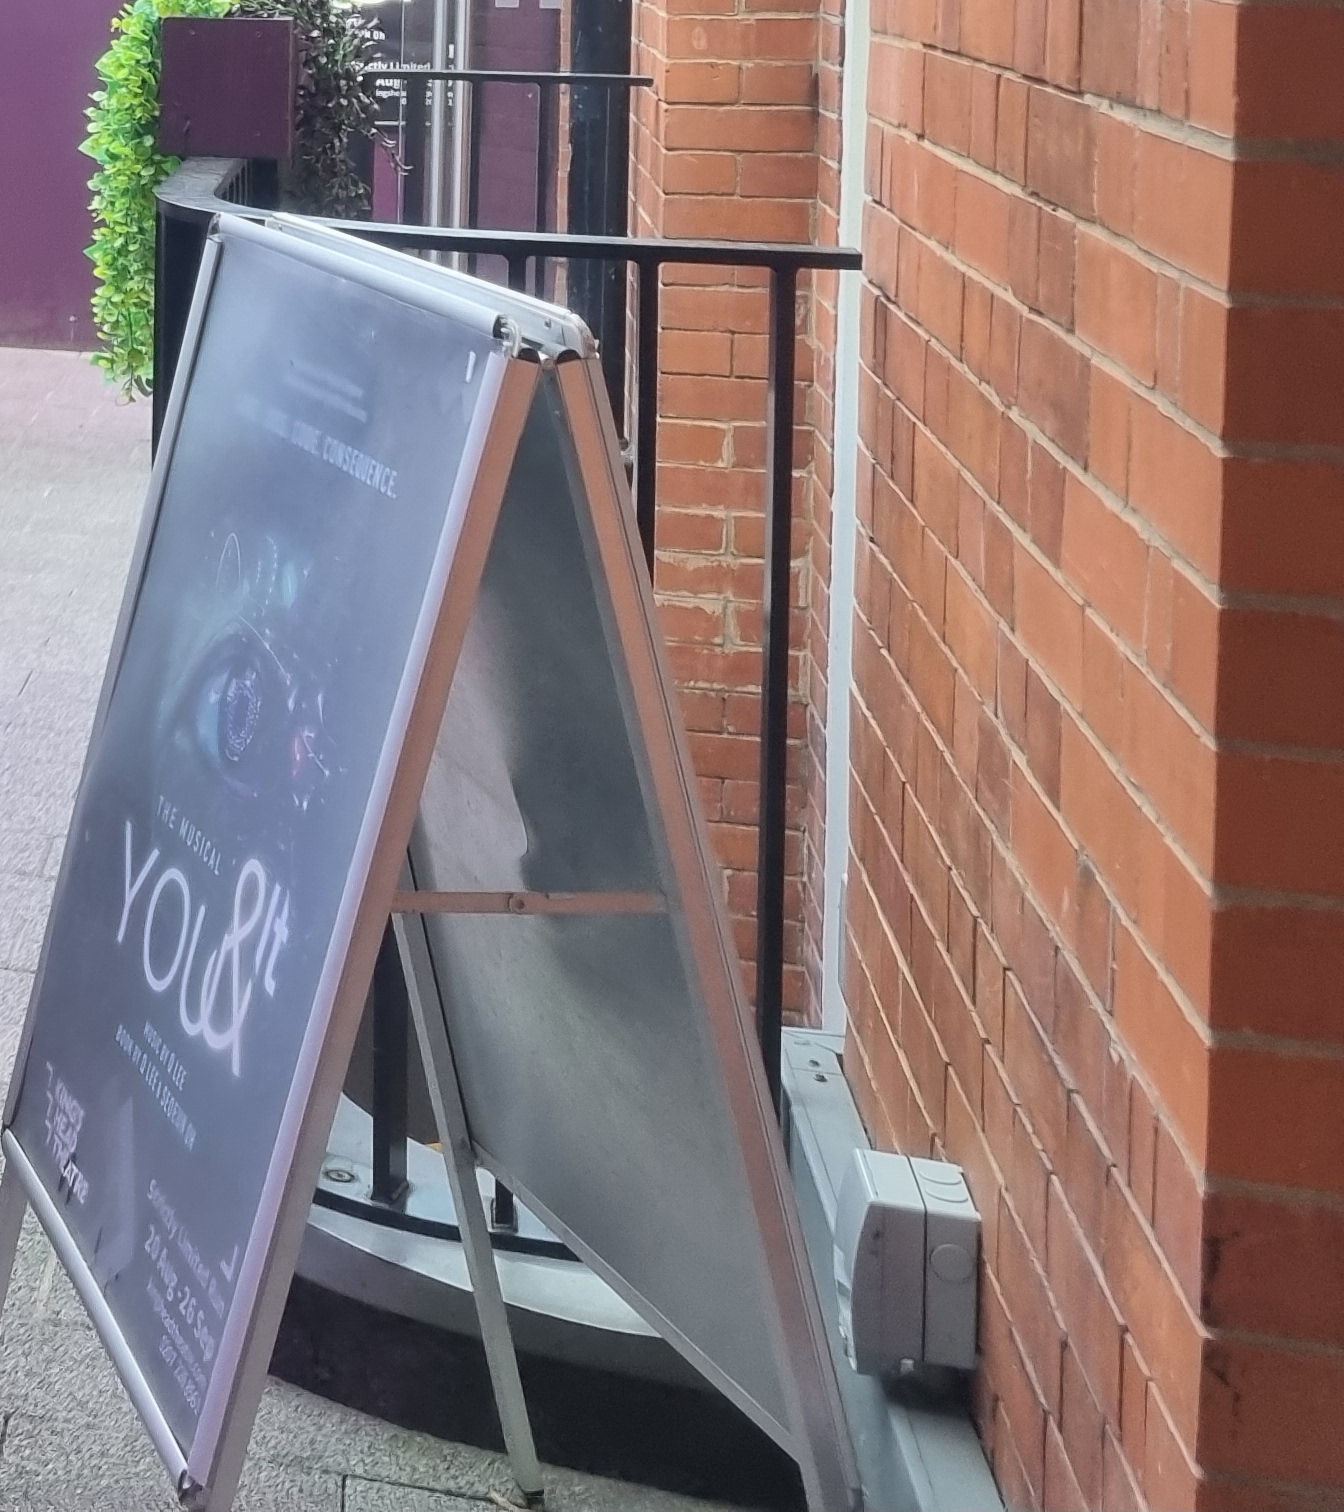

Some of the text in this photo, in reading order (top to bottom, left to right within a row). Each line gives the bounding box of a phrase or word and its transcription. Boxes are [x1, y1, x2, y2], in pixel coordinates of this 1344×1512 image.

[156, 795, 222, 876] THE MUSICAL
[144, 1223, 161, 1261] 20
